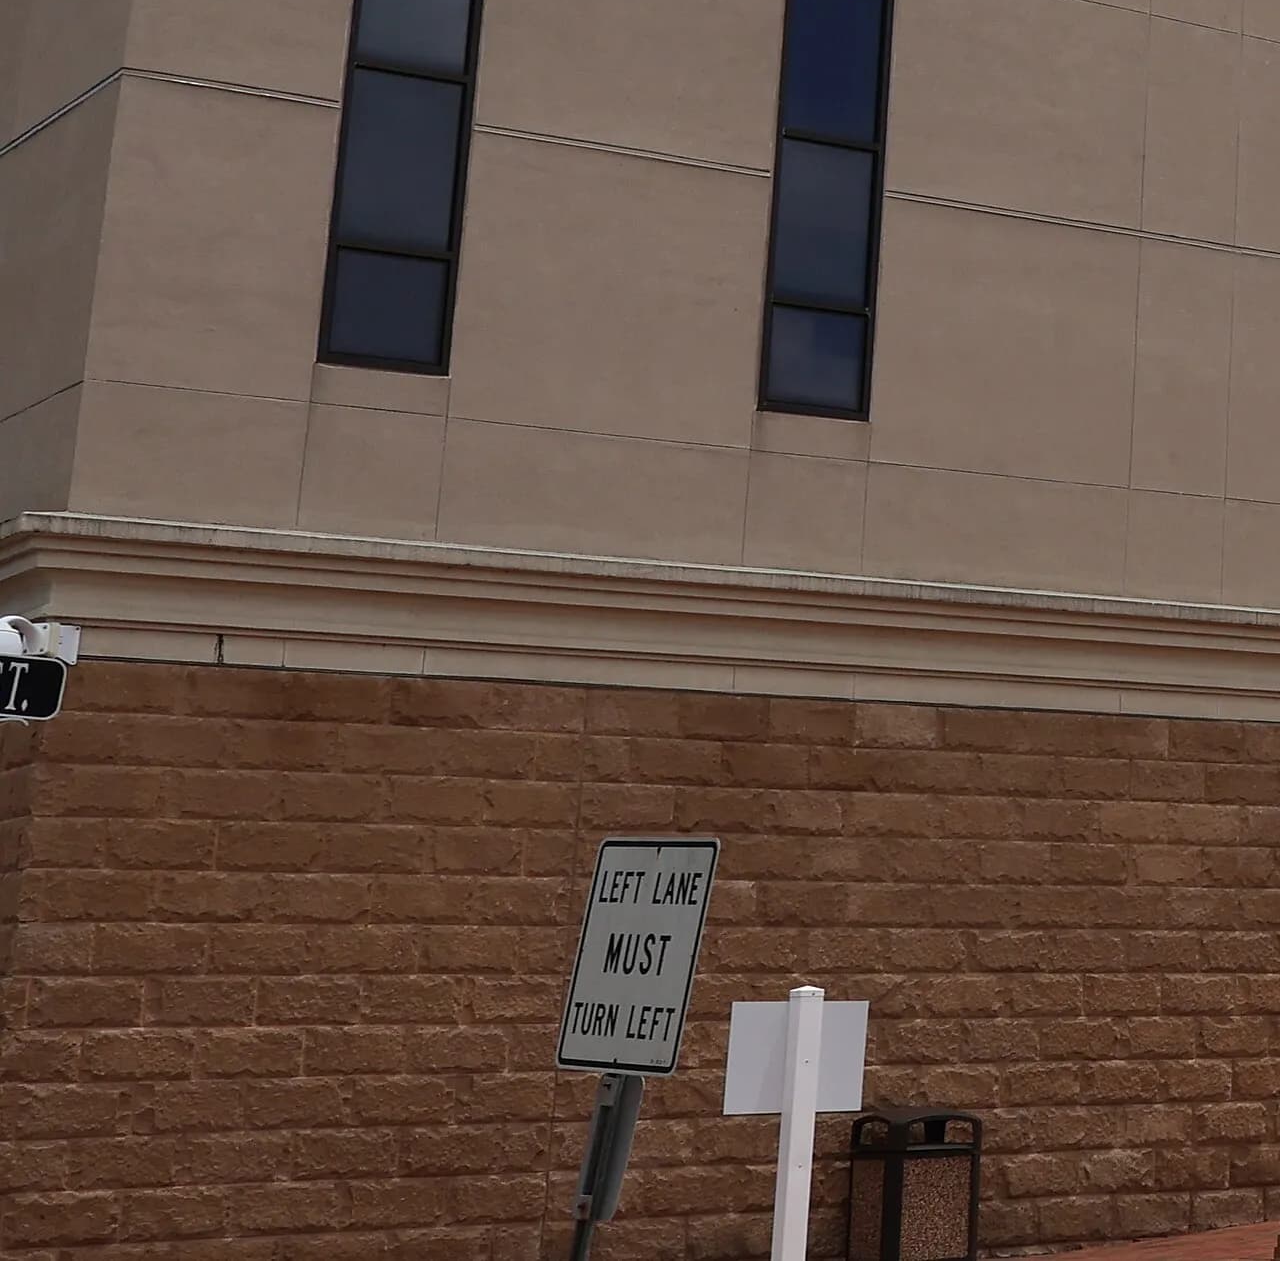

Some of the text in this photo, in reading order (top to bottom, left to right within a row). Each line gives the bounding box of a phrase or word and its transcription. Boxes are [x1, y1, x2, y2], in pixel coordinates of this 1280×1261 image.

[598, 869, 704, 906] LEFT LANE
[603, 932, 672, 977] MUST
[570, 1001, 676, 1042] TURN LEFT
